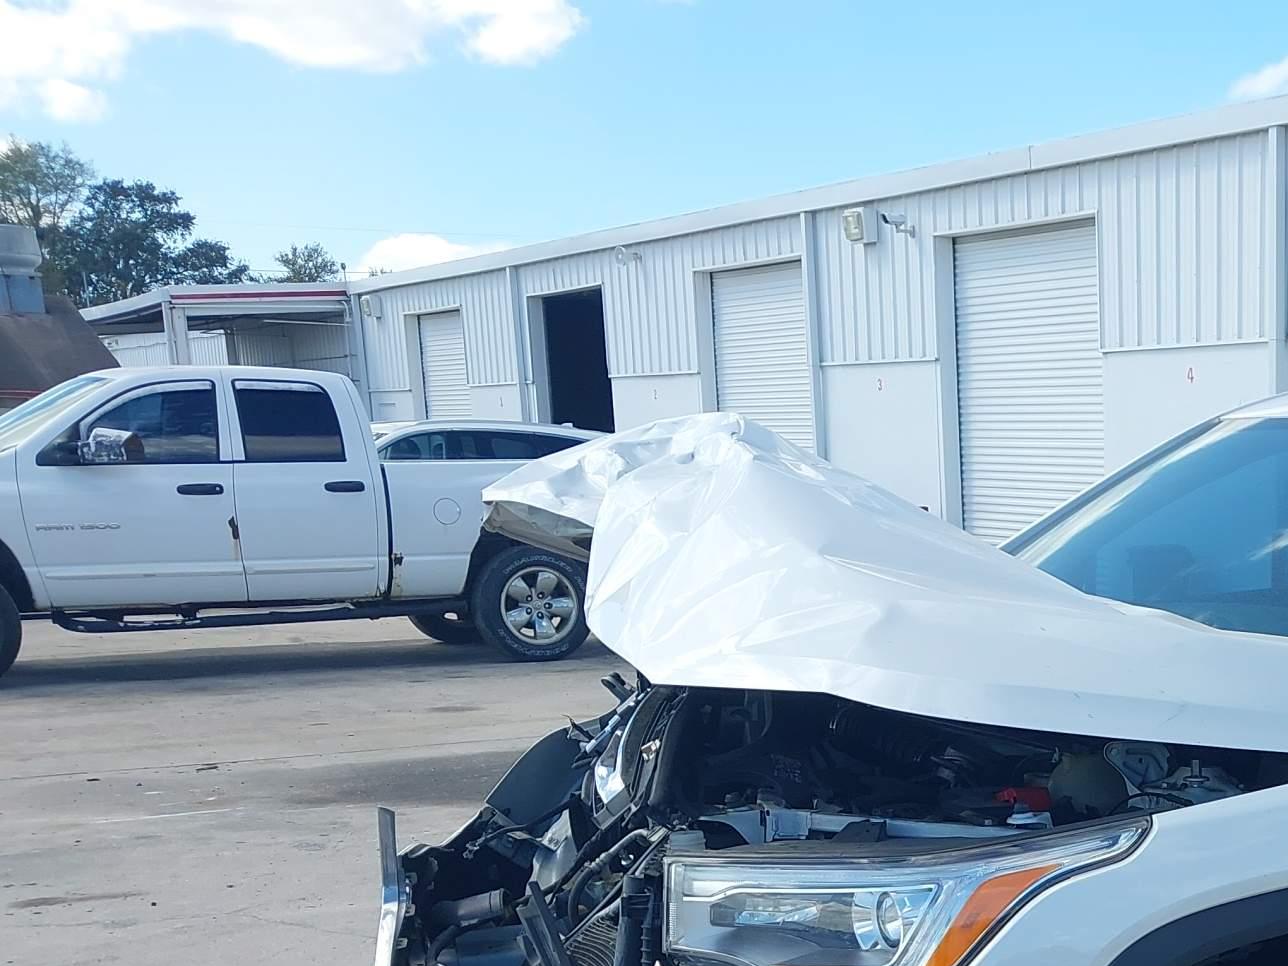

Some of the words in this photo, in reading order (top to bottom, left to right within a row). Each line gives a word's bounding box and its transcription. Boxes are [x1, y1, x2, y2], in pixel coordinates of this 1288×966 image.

[1187, 367, 1195, 384] 4
[877, 377, 883, 391] 3
[35, 523, 75, 531] RAM
[79, 522, 121, 530] 1500
